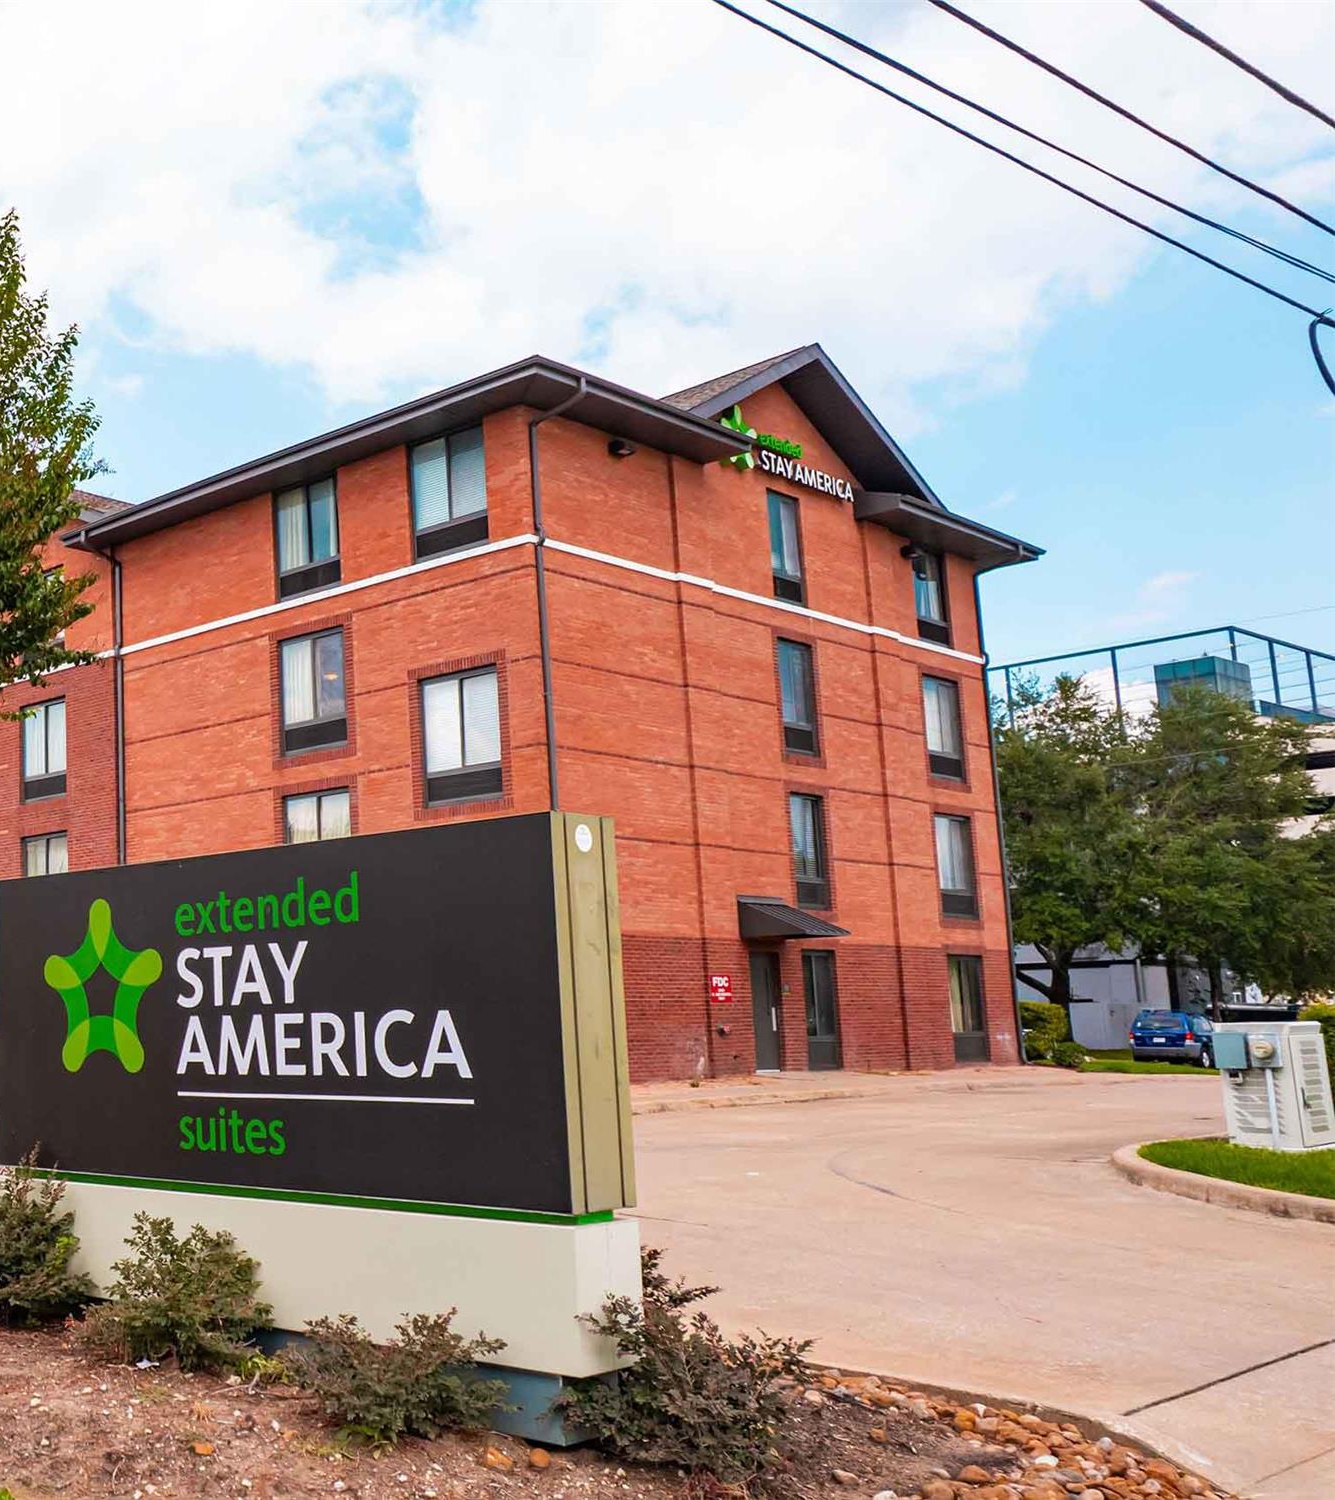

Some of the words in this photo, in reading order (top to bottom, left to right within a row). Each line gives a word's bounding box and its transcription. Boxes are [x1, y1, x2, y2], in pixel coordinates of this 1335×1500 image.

[758, 434, 803, 458] extended
[761, 450, 793, 480] STAY
[795, 466, 854, 502] AMERICA
[174, 871, 359, 936] extended
[176, 940, 308, 1008] STAY
[712, 976, 729, 987] FDC
[176, 1009, 473, 1079] AMERICA
[179, 1106, 286, 1155] suites
